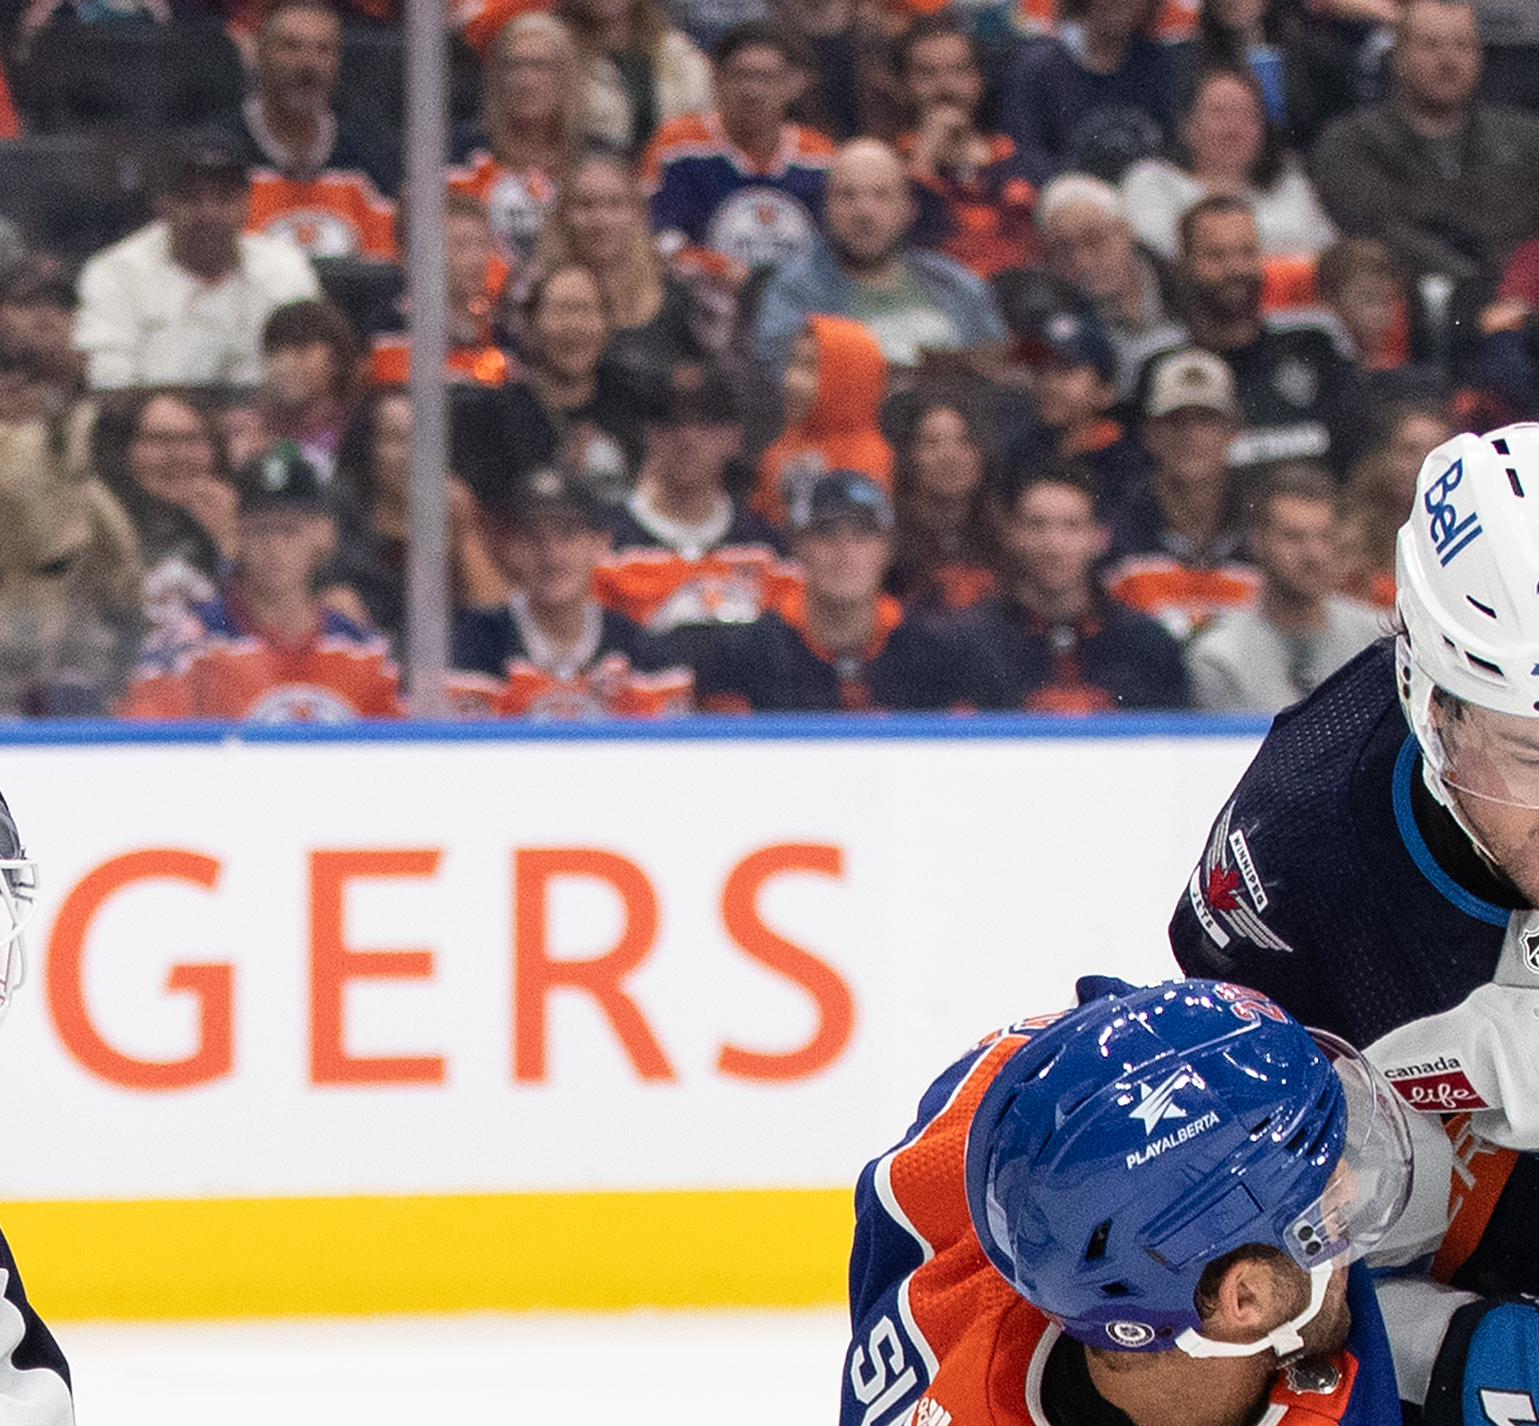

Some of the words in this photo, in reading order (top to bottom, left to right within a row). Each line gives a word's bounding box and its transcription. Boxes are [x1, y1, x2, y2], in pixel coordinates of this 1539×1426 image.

[1423, 456, 1483, 568] Bell
[1232, 835, 1265, 905] WINNIPEG
[1191, 891, 1214, 930] JETS
[1383, 1056, 1462, 1079] canada
[1408, 1082, 1480, 1108] life
[1125, 1110, 1221, 1170] PLAYALBERTA
